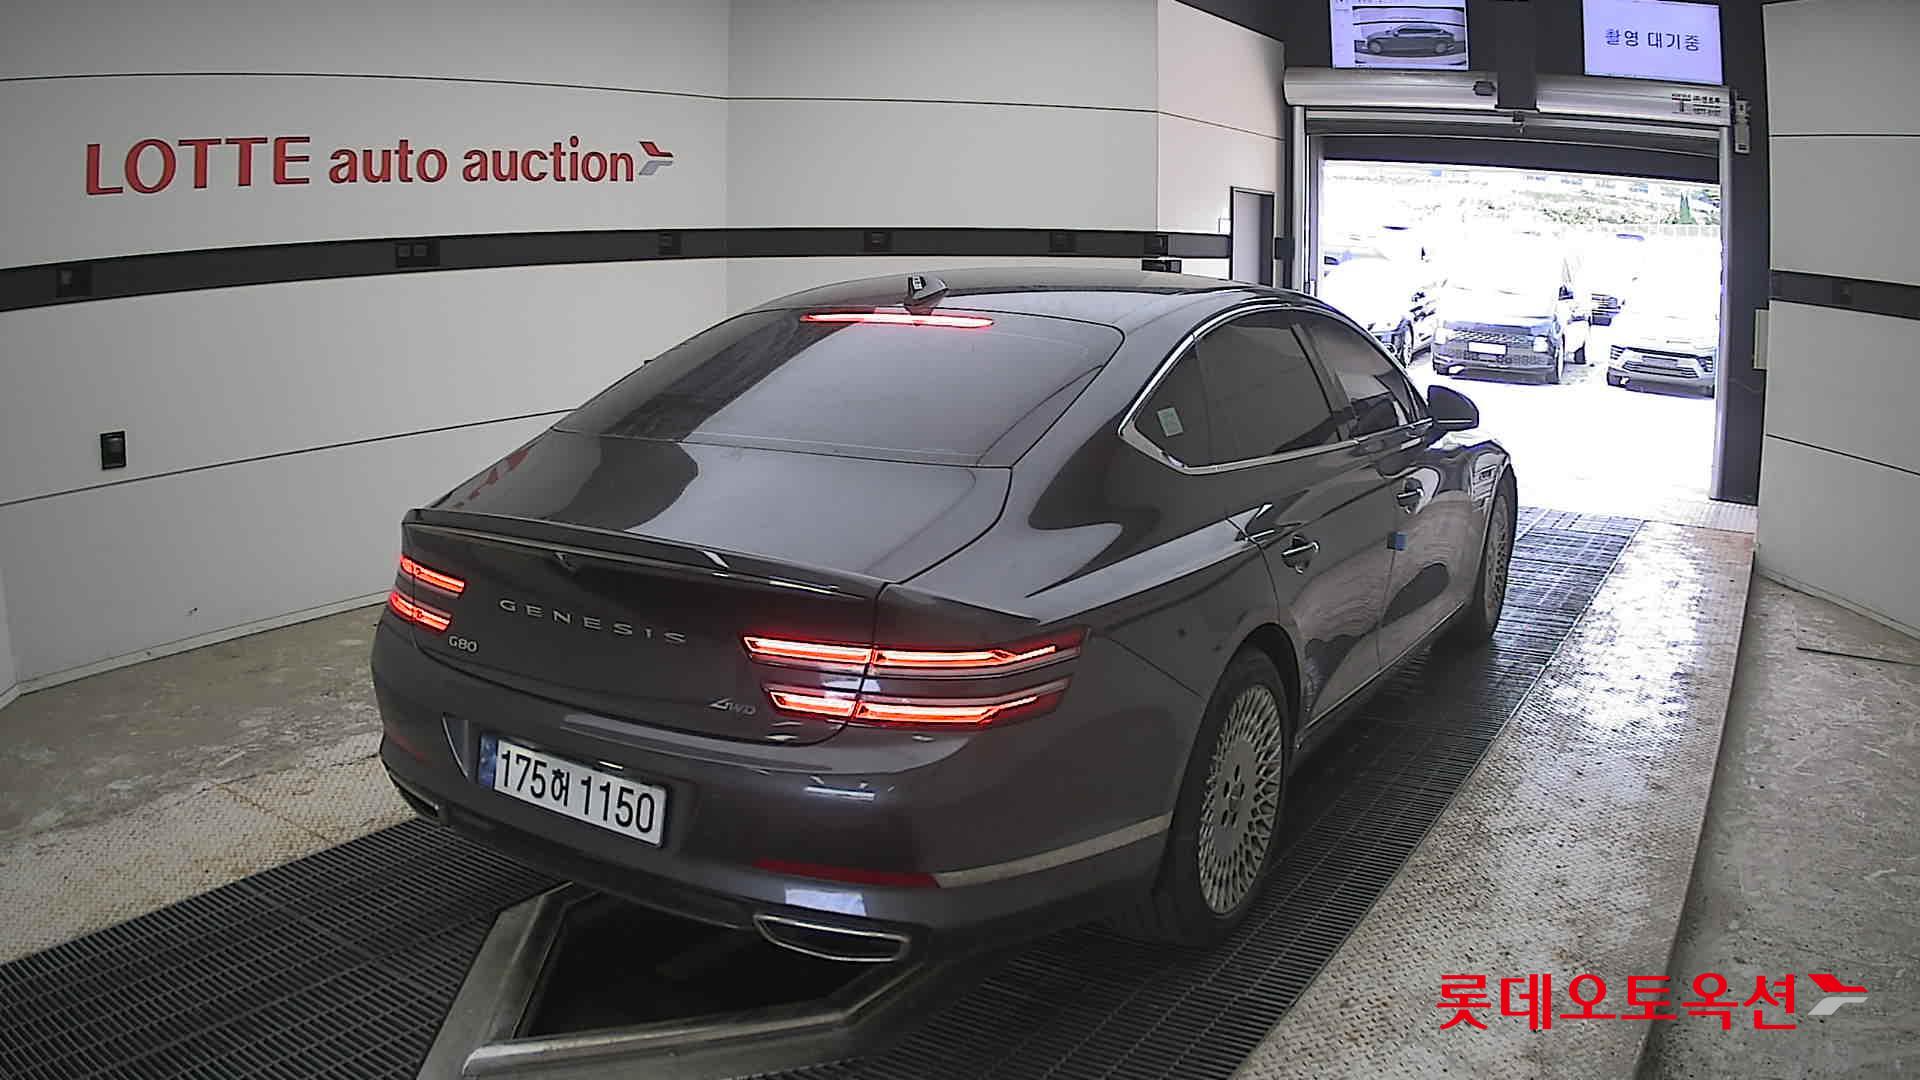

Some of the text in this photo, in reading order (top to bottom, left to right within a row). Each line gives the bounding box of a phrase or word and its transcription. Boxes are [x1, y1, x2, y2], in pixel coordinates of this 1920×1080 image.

[1647, 32, 1699, 51] 대기중
[85, 135, 636, 197] LOTTE auto auction
[500, 599, 687, 643] GENESIS
[447, 634, 479, 654] G80
[581, 775, 655, 833] 1150
